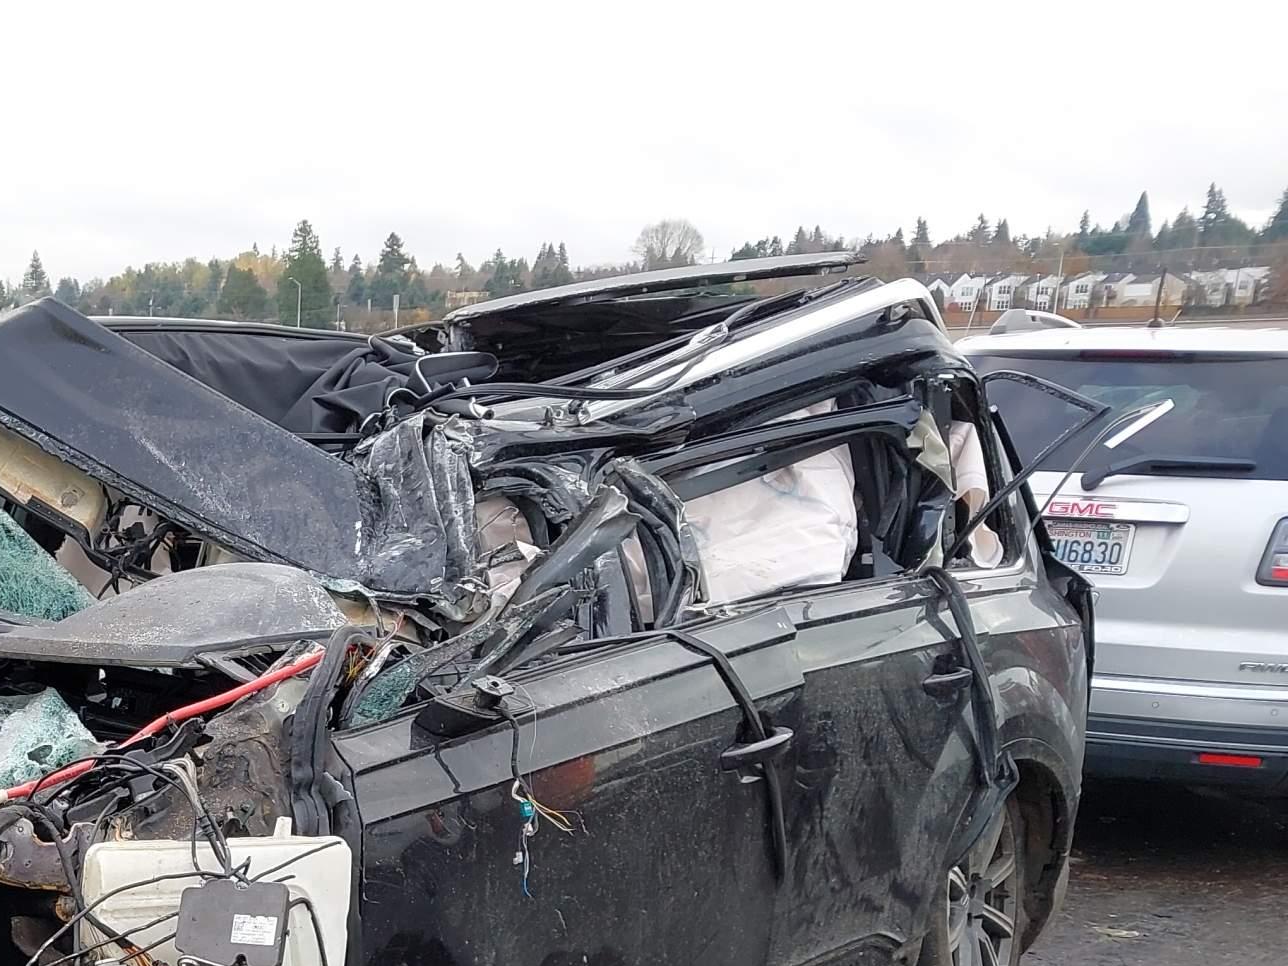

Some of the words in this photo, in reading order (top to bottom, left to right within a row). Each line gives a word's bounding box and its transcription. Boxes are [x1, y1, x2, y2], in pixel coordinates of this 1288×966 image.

[1048, 501, 1117, 517] GMC
[1048, 529, 1092, 538] SHINGTON
[1052, 539, 1122, 565] U6830
